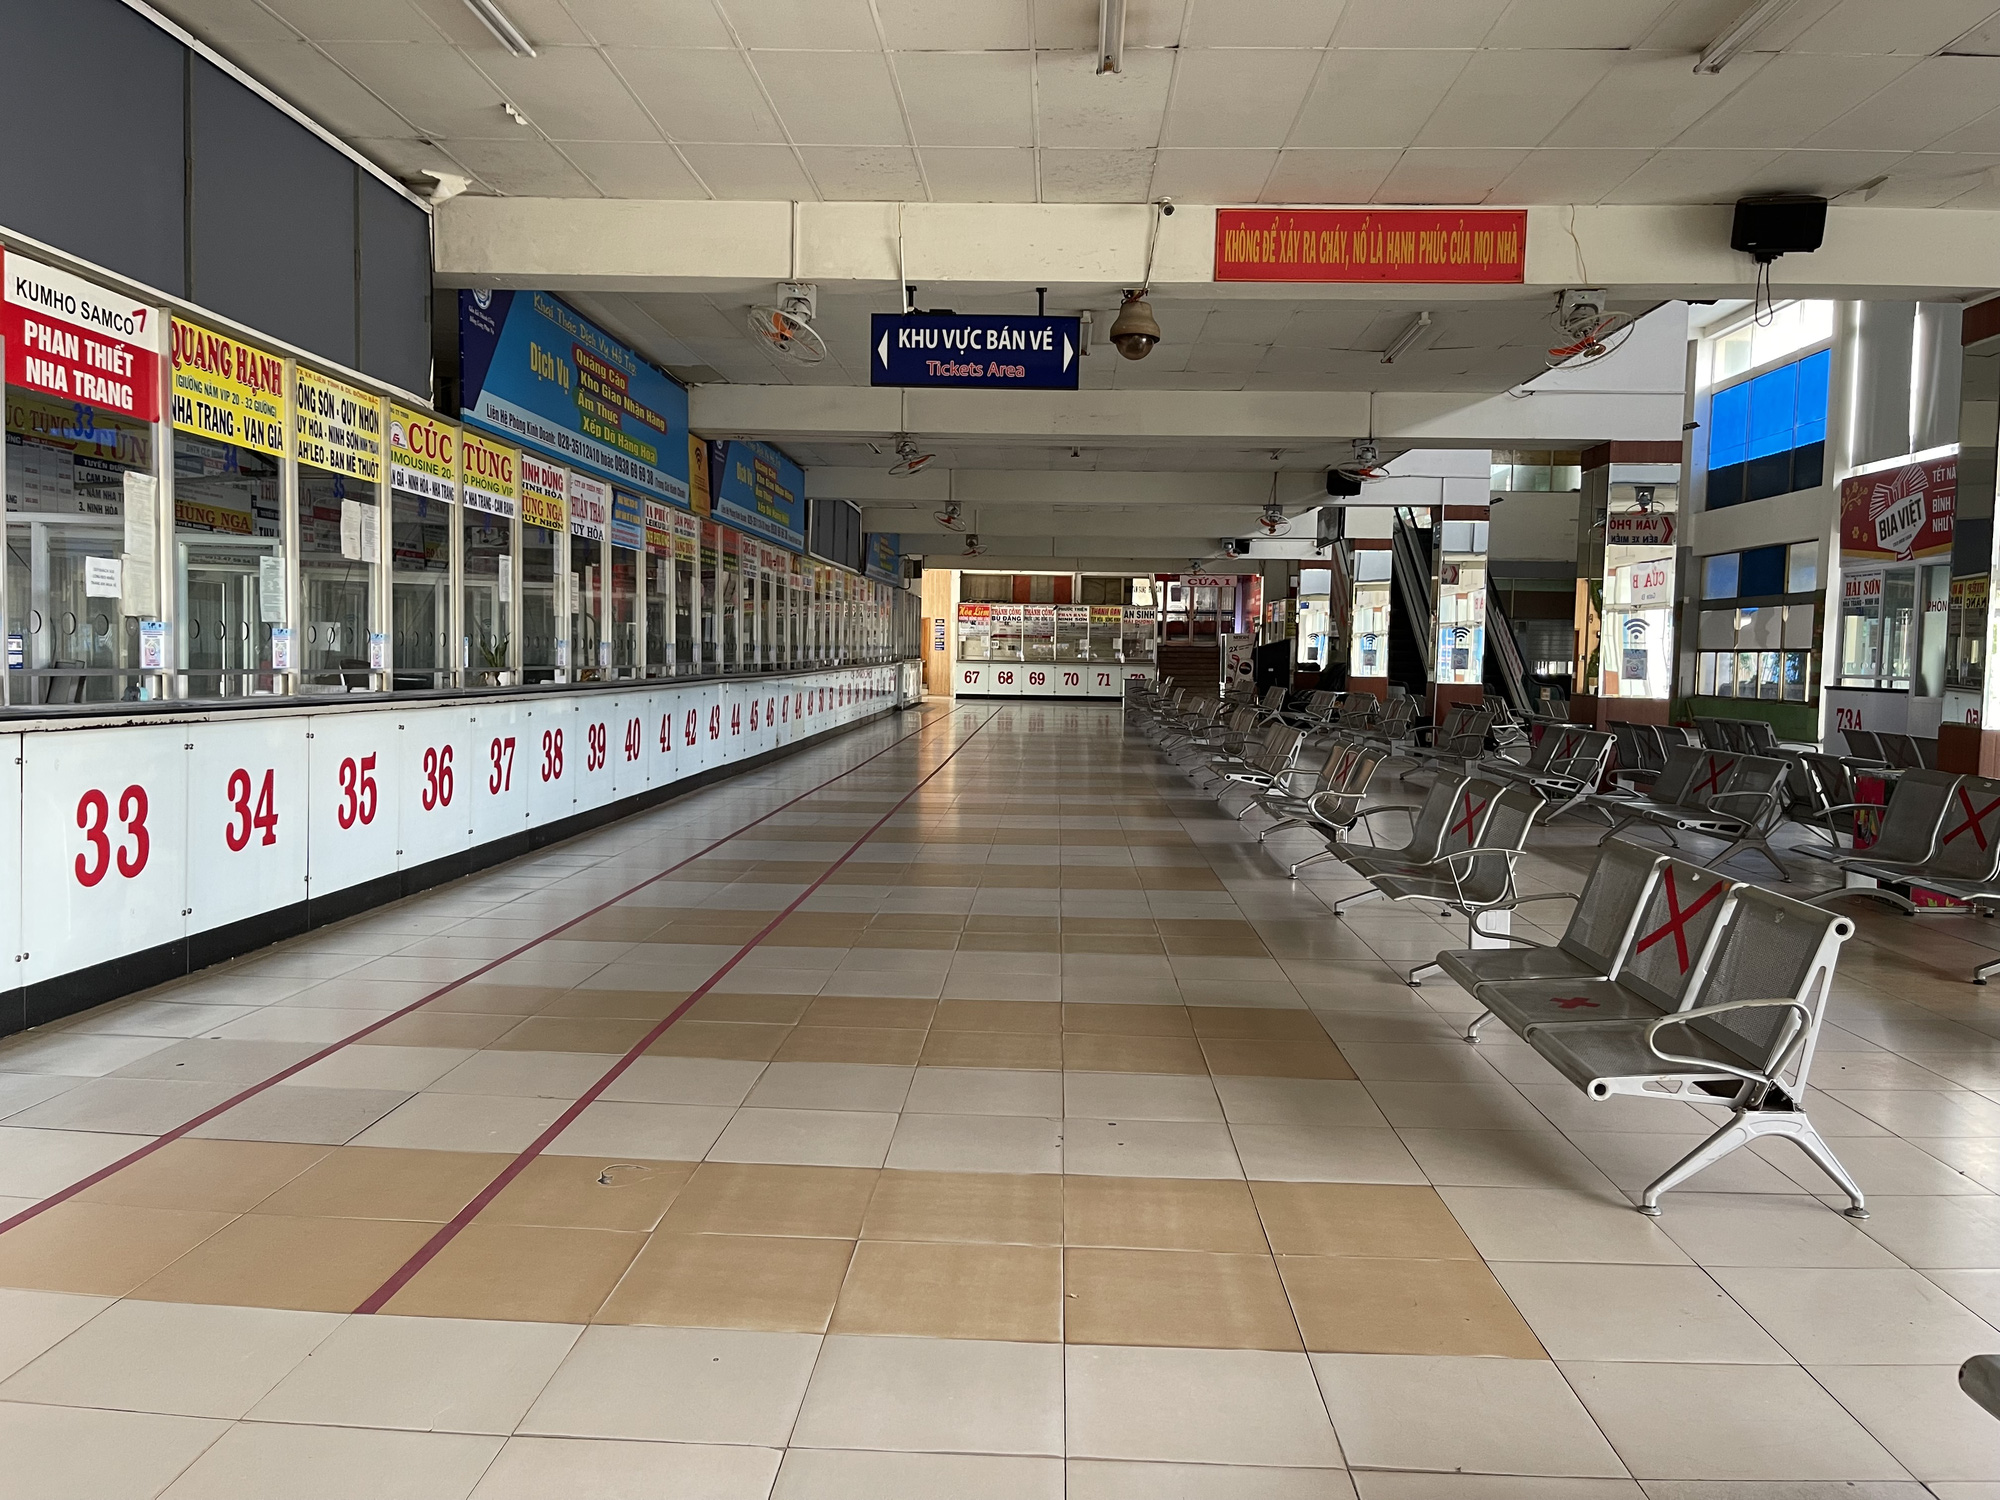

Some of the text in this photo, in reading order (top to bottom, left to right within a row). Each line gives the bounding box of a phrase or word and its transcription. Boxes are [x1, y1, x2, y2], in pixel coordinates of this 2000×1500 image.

[1225, 216, 1518, 271] KHÔNG ĐỂ XẢY RA CHÁY, NỔ LÀ HẠNH PHÚC CỦA MỌI NHÀ
[16, 277, 134, 336] KUMHO SAMCO
[534, 292, 553, 318] Khai
[24, 319, 134, 378] PHAN THIẾT
[172, 320, 282, 397] QUANG HẠNH
[899, 326, 1053, 355] KHU VỰC BÁN VÉ
[26, 356, 133, 411] NHA TRANG
[530, 341, 569, 395] Dịch Vụ
[576, 348, 626, 390] Quảng Cáo
[926, 360, 1025, 378] Tickets Area
[220, 388, 231, 402] VIP
[232, 393, 240, 405] 20
[245, 397, 252, 409] 32
[318, 388, 335, 419] SƠN
[341, 398, 357, 427] QUY
[359, 405, 379, 435] NHƠN
[486, 403, 499, 422] Liên
[578, 388, 618, 425] Ẩm Thực
[580, 370, 665, 432] Kho Giao Nhận Hàng
[73, 403, 95, 439] 33
[172, 394, 193, 426] NHA
[197, 402, 234, 437] TRANG
[244, 416, 264, 448] VẠN
[309, 415, 323, 439] HÒA
[328, 425, 345, 447] NINH
[583, 416, 602, 437] Xếp
[618, 434, 639, 456] Hàng
[409, 420, 453, 464] CÚC
[330, 449, 345, 470] BAN
[346, 452, 356, 473] MÊ
[391, 451, 439, 475] IMOUSINE
[462, 439, 513, 484] TÙNG
[471, 475, 514, 497] PHÒNG VIP
[221, 512, 249, 531] NGA
[547, 502, 563, 522] NGA
[1879, 513, 1898, 541] BIA
[1898, 498, 1921, 529] VIỆT
[587, 525, 604, 541] HÒA
[1846, 577, 1881, 596] HẢI SƠN
[1124, 610, 1155, 619] AN SINH
[964, 670, 980, 684] 67
[997, 671, 1013, 685] 68
[1029, 671, 1045, 686] 69
[1063, 672, 1079, 686] 70
[1097, 673, 1111, 686] 71
[731, 703, 740, 736] 44
[750, 699, 759, 731] 45
[766, 697, 774, 727] 46
[782, 695, 789, 723] 47
[795, 692, 802, 719] 48
[808, 690, 814, 716] 49
[1836, 708, 1862, 733] 73A
[625, 717, 641, 761] 40
[660, 713, 671, 752] 41
[685, 708, 697, 746] 42
[709, 704, 720, 740] 43
[542, 728, 563, 782] 38
[588, 722, 606, 771] 39
[423, 744, 454, 811] 36
[489, 737, 515, 795] 37
[338, 751, 377, 830] 35
[226, 768, 278, 852] 34
[75, 784, 150, 887] 33
